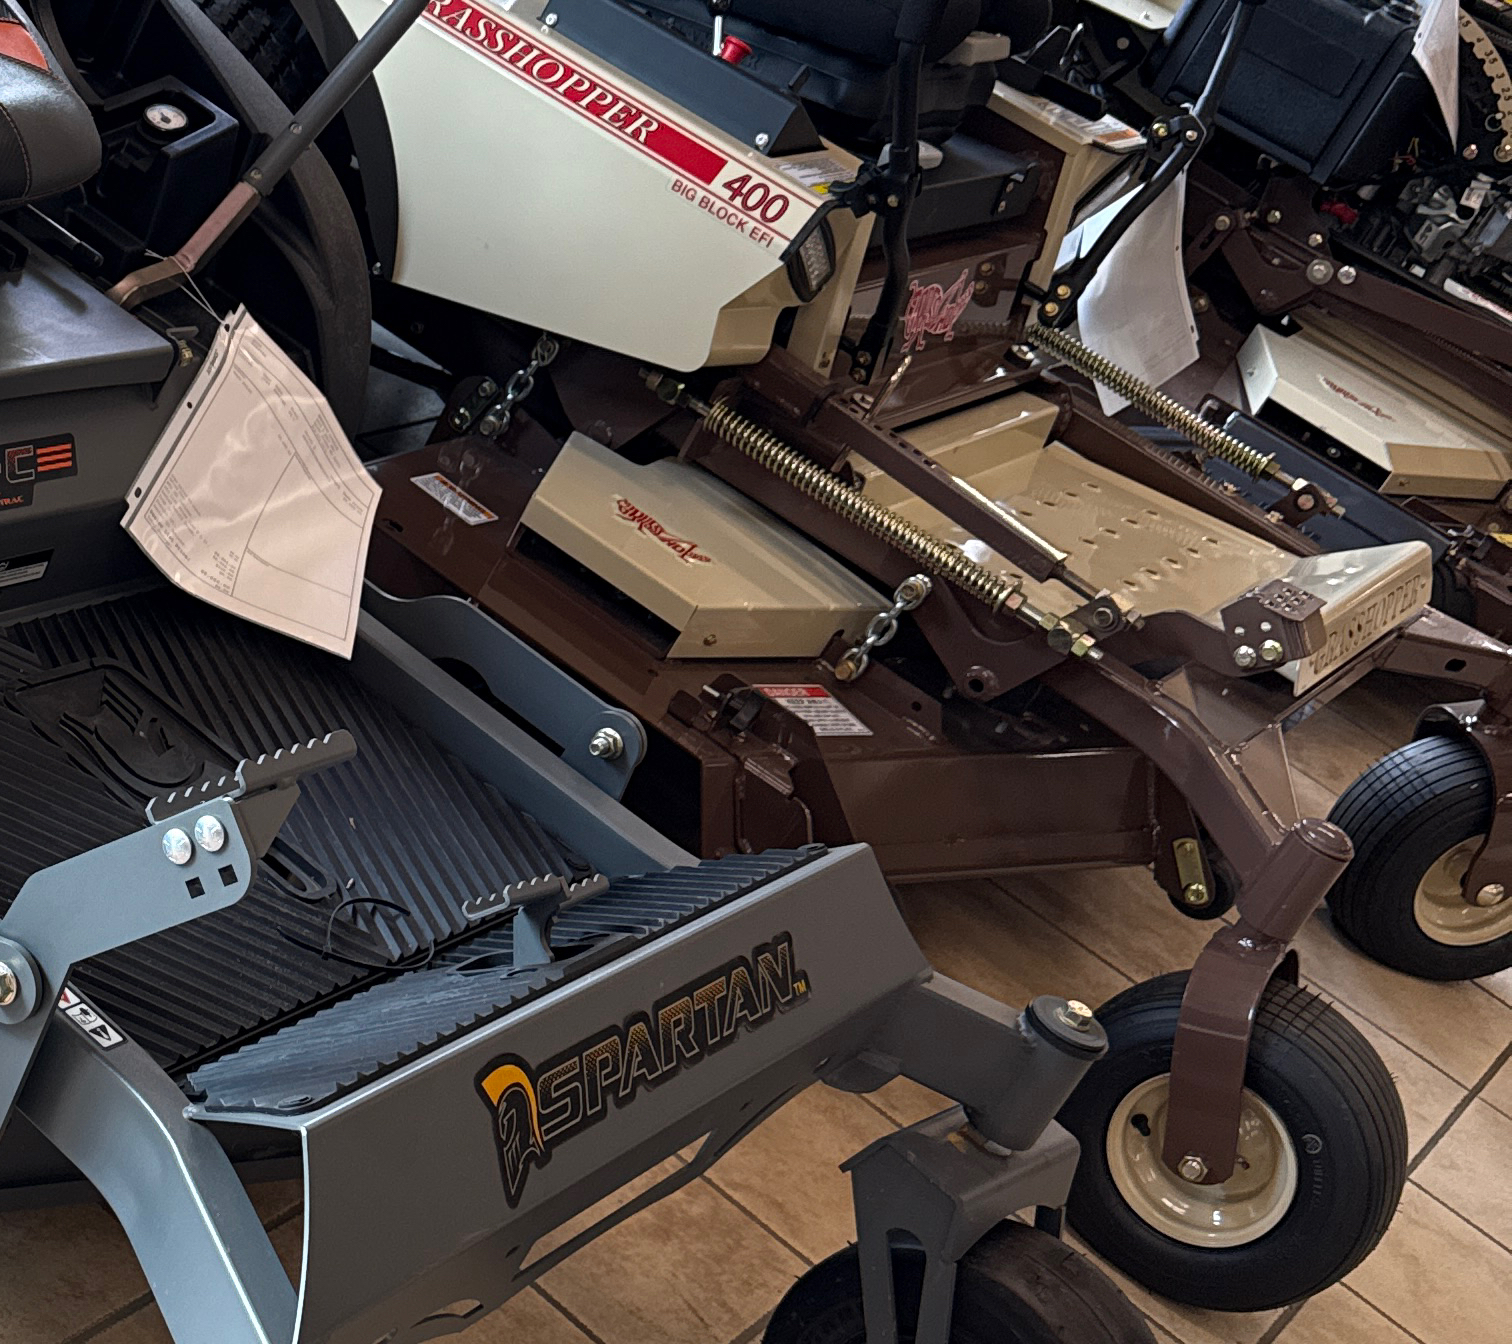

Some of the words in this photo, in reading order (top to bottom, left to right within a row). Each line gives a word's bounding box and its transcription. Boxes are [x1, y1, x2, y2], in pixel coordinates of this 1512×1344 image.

[670, 178, 699, 203] BIG
[698, 195, 750, 234] BLOCK
[748, 225, 775, 249] EFI
[722, 173, 790, 224] 400
[538, 942, 793, 1142] SPARTAN
